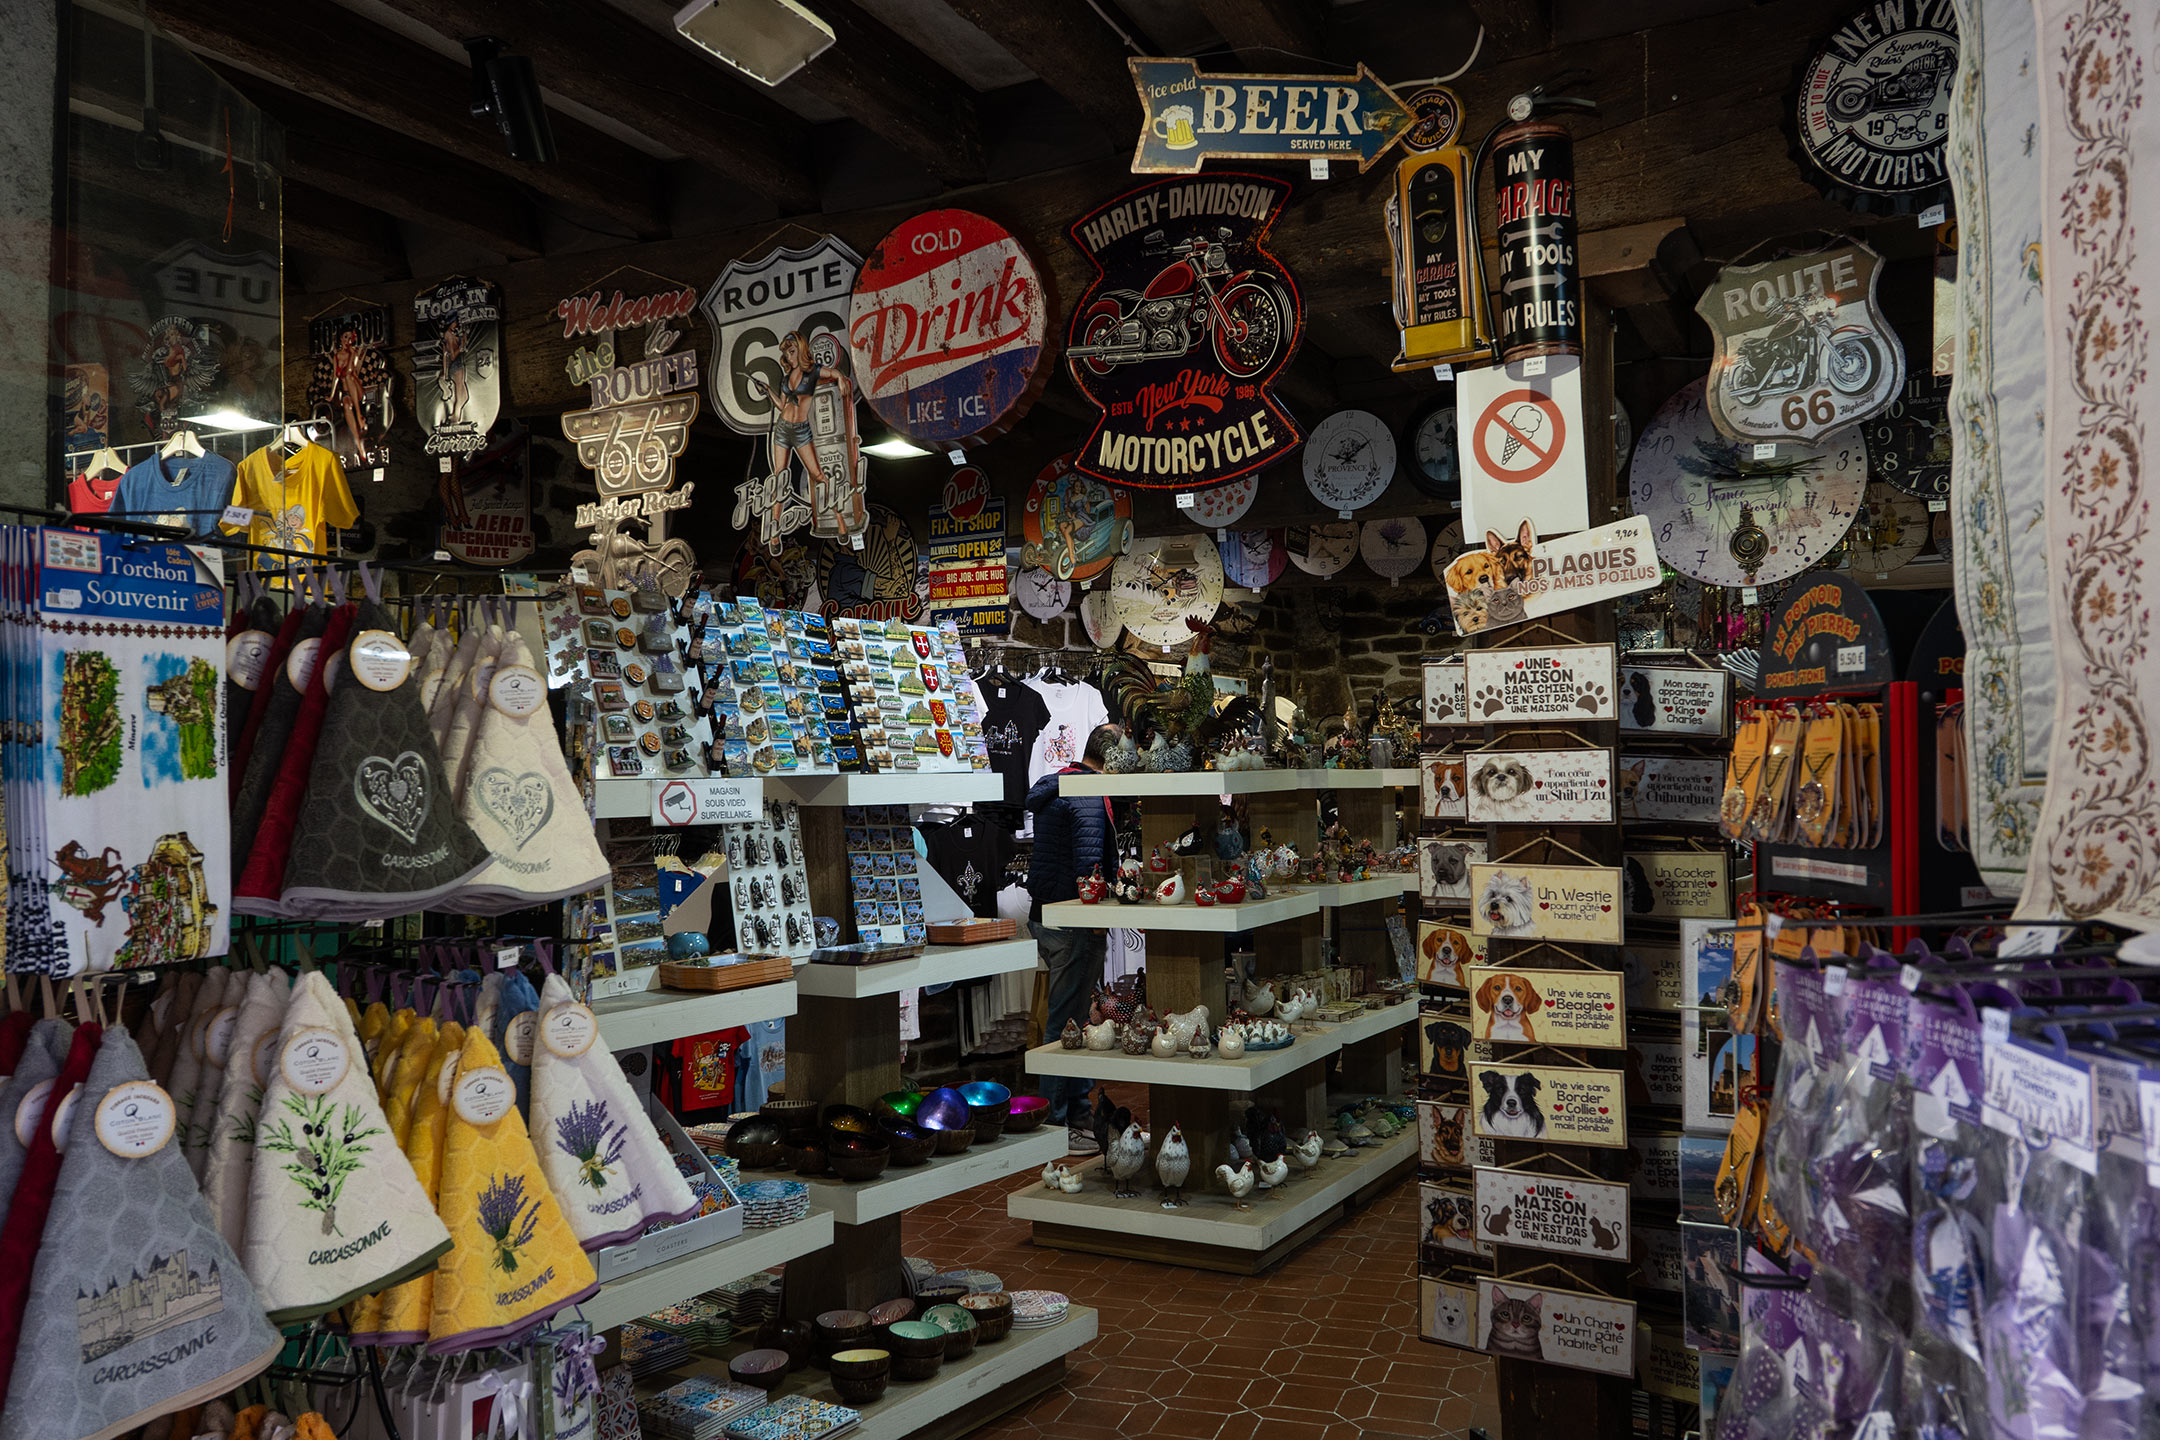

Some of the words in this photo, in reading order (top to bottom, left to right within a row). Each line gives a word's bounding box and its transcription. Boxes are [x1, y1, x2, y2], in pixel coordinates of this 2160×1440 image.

[1832, 0, 1905, 58] NEW
[1148, 84, 1168, 99] Ice
[1170, 77, 1197, 95] cold
[1813, 68, 1831, 92] RIDE
[1811, 93, 1823, 106] TO
[1197, 85, 1363, 135] BEER
[1811, 110, 1826, 131] LIVE
[1867, 120, 1884, 137] 19
[1290, 139, 1325, 150] SERVED
[1328, 139, 1352, 150] HERE
[1507, 149, 1544, 176] MY
[1083, 183, 1276, 252] HARLEY-DAVIDSON
[911, 227, 962, 255] COLD
[1427, 253, 1441, 264] MY
[1523, 245, 1573, 268] TOOLS
[1416, 262, 1457, 284] GARAGE
[724, 261, 842, 313] ROUTE
[1434, 287, 1457, 300] TOOLS
[1724, 254, 1858, 321] ROUTE
[414, 297, 463, 322] TOOL
[466, 288, 488, 304] IN
[558, 288, 697, 337] Welcome
[1420, 312, 1432, 324] MY
[1433, 308, 1457, 321] RULES
[1524, 300, 1575, 329] RULES
[852, 256, 1031, 392] Drink
[646, 320, 680, 355] to
[566, 342, 615, 386] the
[590, 350, 699, 410] ROUTE
[1908, 380, 1920, 398] 11
[1135, 380, 1181, 420] New
[1178, 369, 1231, 409] York
[907, 399, 945, 423] LIKE
[958, 395, 986, 418] ICE
[1111, 401, 1134, 416] ESTB
[1781, 389, 1836, 431] 66
[1100, 409, 1275, 474] MOTORCYCLE
[1651, 434, 1675, 455] 10
[1877, 426, 1893, 446] 9
[601, 407, 667, 487] 66
[1328, 465, 1368, 473] PROVENCE
[1836, 450, 1849, 472] 3
[1882, 452, 1898, 471] 8
[1908, 470, 1922, 488] 7
[732, 468, 791, 530] Fill
[942, 477, 990, 513] Dad's
[1641, 482, 1653, 503] 9
[474, 514, 524, 533] AERO
[761, 503, 813, 542] her
[931, 517, 966, 536] FIX-IT
[968, 512, 1001, 531] SHOP
[446, 530, 531, 548] MECHANIC'S
[1660, 523, 1673, 543] 8
[466, 546, 509, 559] MATE
[930, 544, 958, 556] ALWAYS
[958, 541, 988, 557] OPEN
[990, 540, 1003, 551] 24
[1794, 535, 1807, 556] 5
[1533, 547, 1637, 578] PLAQUES
[1696, 550, 1709, 566] 7
[105, 555, 188, 582] Torchon
[946, 571, 957, 583] BIG
[959, 569, 974, 582] JOB:
[975, 569, 989, 581] ONE
[990, 568, 1004, 580] HUG
[1518, 578, 1548, 594] NOS
[1553, 573, 1594, 590] AMIS
[1599, 565, 1656, 585] POILUS
[87, 580, 188, 612] Souvenir
[932, 584, 953, 598] SMALL
[954, 584, 970, 596] JOB:
[970, 584, 986, 596] TWO
[987, 583, 1004, 594] HUGS
[973, 609, 1006, 625] ADVICE
[1773, 624, 1788, 656] LE
[1783, 584, 1842, 633] POUVOIR
[1785, 622, 1807, 663] DES
[1806, 611, 1860, 642] PIERRES
[1525, 657, 1551, 669] UNE
[1838, 651, 1857, 666] 9.50
[1858, 651, 1864, 665] €
[1504, 669, 1573, 684] MAISON
[1663, 679, 1682, 688] Mon
[1765, 669, 1796, 688] POWER
[1796, 666, 1826, 685] STONE
[1505, 684, 1533, 695] SANS
[1537, 683, 1574, 693] CHIEN
[1658, 689, 1706, 698] appartient
[1505, 695, 1518, 705] CE
[1521, 694, 1550, 704] N'EST
[1554, 693, 1575, 703] PAS
[1511, 705, 1528, 713] UNE
[1530, 703, 1568, 713] MAISON
[1673, 697, 1713, 707] Cavalier
[1667, 715, 1703, 725] Charles
[1674, 705, 1695, 717] King
[709, 787, 740, 796] MAGASIN
[1551, 789, 1578, 800] Shih
[1646, 792, 1715, 805] Chihuahua
[705, 799, 725, 808] SOUS
[726, 799, 746, 807] VIDEO
[701, 810, 752, 820] SURVEILLANCE
[381, 841, 449, 868] CARCASSONNE
[1655, 868, 1671, 878] Un
[1674, 867, 1716, 878] Cocker
[1664, 878, 1708, 890] Spaniel
[1538, 887, 1557, 901] Un
[1561, 888, 1612, 903] Westie
[1550, 903, 1577, 912] pourri
[1580, 903, 1600, 914] gâté
[1554, 911, 1582, 920] habite
[1547, 988, 1566, 997] Une
[1569, 989, 1583, 998] vie
[1586, 991, 1611, 1000] sans
[1547, 1010, 1573, 1020] serait
[1575, 1011, 1614, 1022] possible
[1556, 998, 1603, 1016] Beagle
[1552, 1019, 1574, 1028] mais
[1575, 1019, 1609, 1030] pénible
[1655, 1054, 1676, 1063] Mon
[1550, 1080, 1568, 1089] Une
[1570, 1082, 1584, 1091] vie
[1587, 1084, 1611, 1092] sans
[1557, 1091, 1604, 1104] Border
[1566, 1103, 1597, 1115] Collie
[1550, 1113, 1576, 1122] serait
[1577, 1114, 1614, 1125] possible
[1555, 1122, 1576, 1131] mais
[1577, 1123, 1609, 1133] pénible
[1649, 1148, 1669, 1157] Mon
[1536, 1185, 1563, 1199] UNE
[1515, 1194, 1586, 1216] MAISON
[1515, 1209, 1548, 1222] SANS
[1552, 1214, 1587, 1227] CHAT
[1515, 1219, 1529, 1230] CE
[1532, 1222, 1562, 1235] N'EST
[1565, 1226, 1588, 1238] PAS
[308, 1220, 391, 1266] CARCASSONNE
[656, 1239, 688, 1254] COASTERS
[1521, 1230, 1539, 1241] UNE
[1541, 1233, 1582, 1246] MAISON
[1564, 1312, 1581, 1325] Un
[1584, 1316, 1614, 1330] Chat
[1553, 1324, 1591, 1338] pourri
[1595, 1330, 1624, 1344] gâté
[1558, 1336, 1597, 1351] habite
[1601, 1344, 1618, 1355] ici!
[93, 1325, 218, 1385] CARCASSONNE
[1660, 1356, 1699, 1375] Husky
